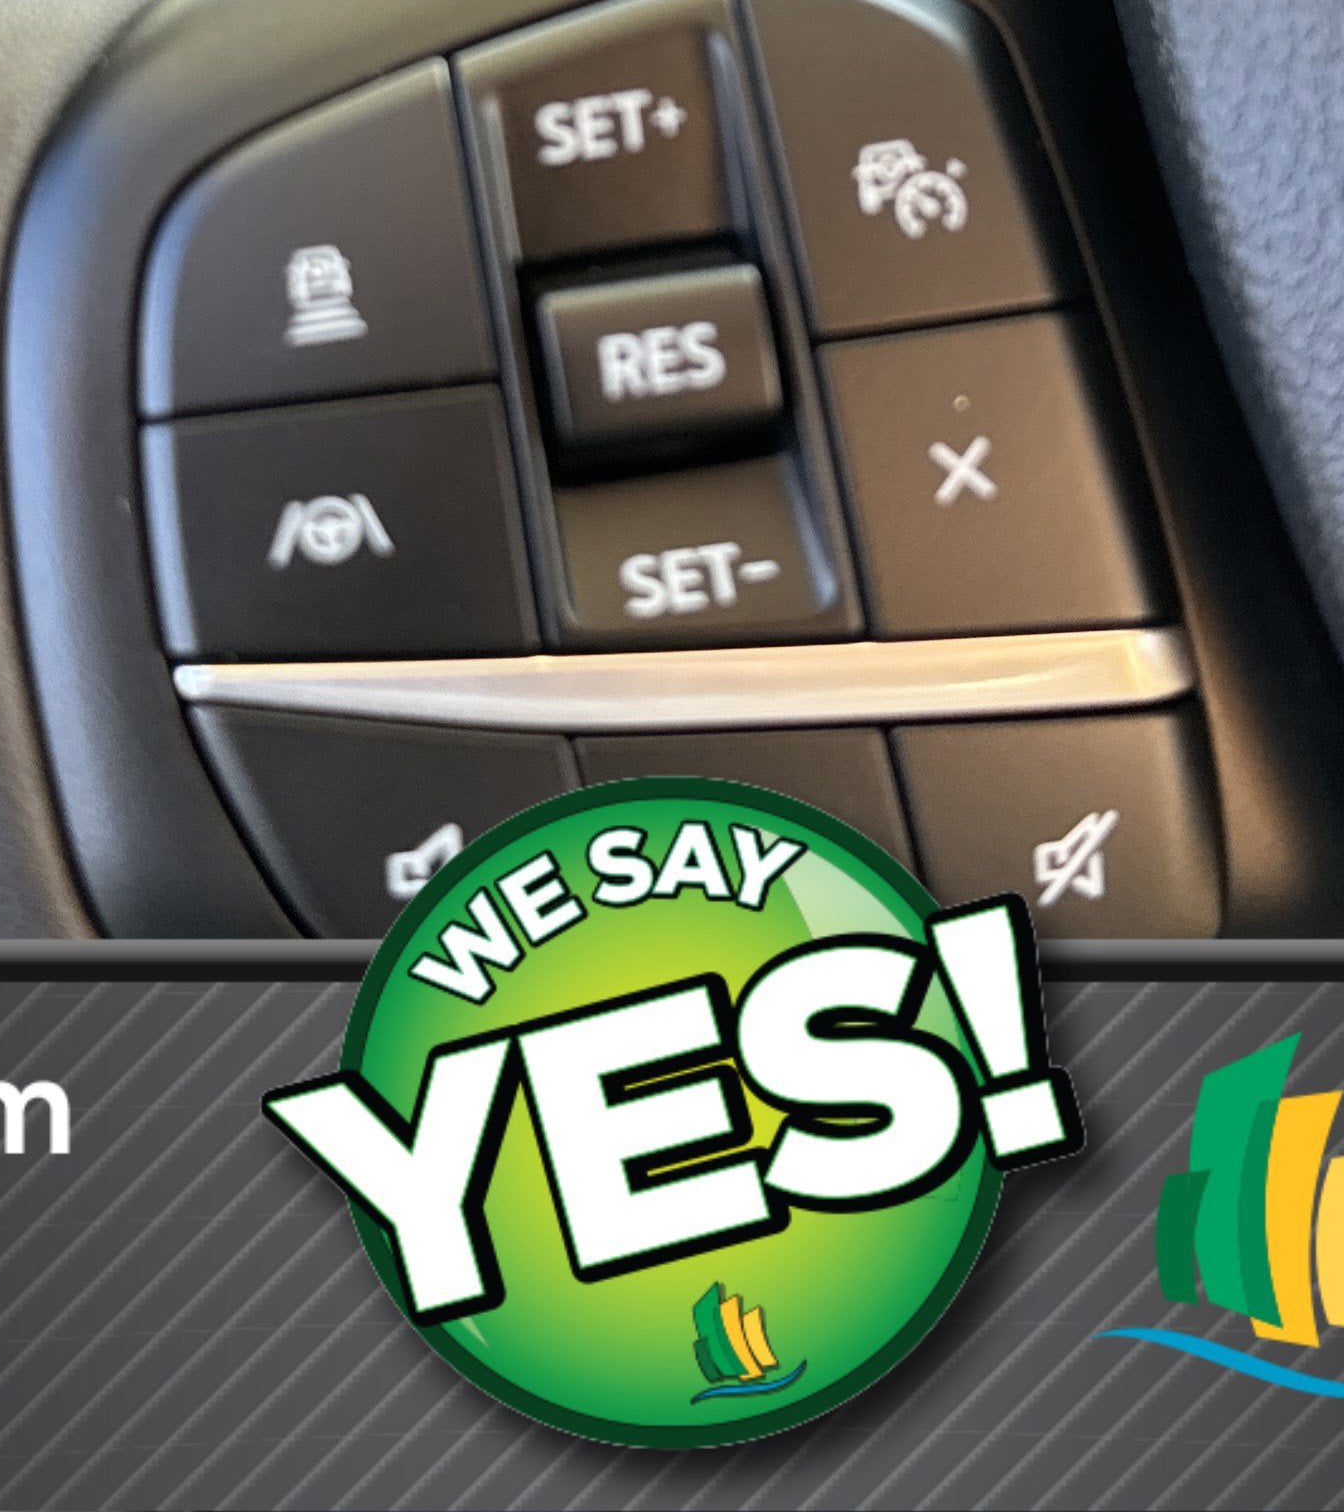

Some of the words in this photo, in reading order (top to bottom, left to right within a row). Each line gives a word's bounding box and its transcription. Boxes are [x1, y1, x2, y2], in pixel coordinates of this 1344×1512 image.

[535, 87, 685, 167] SET+
[597, 320, 727, 400] RES
[619, 541, 779, 619] SET-
